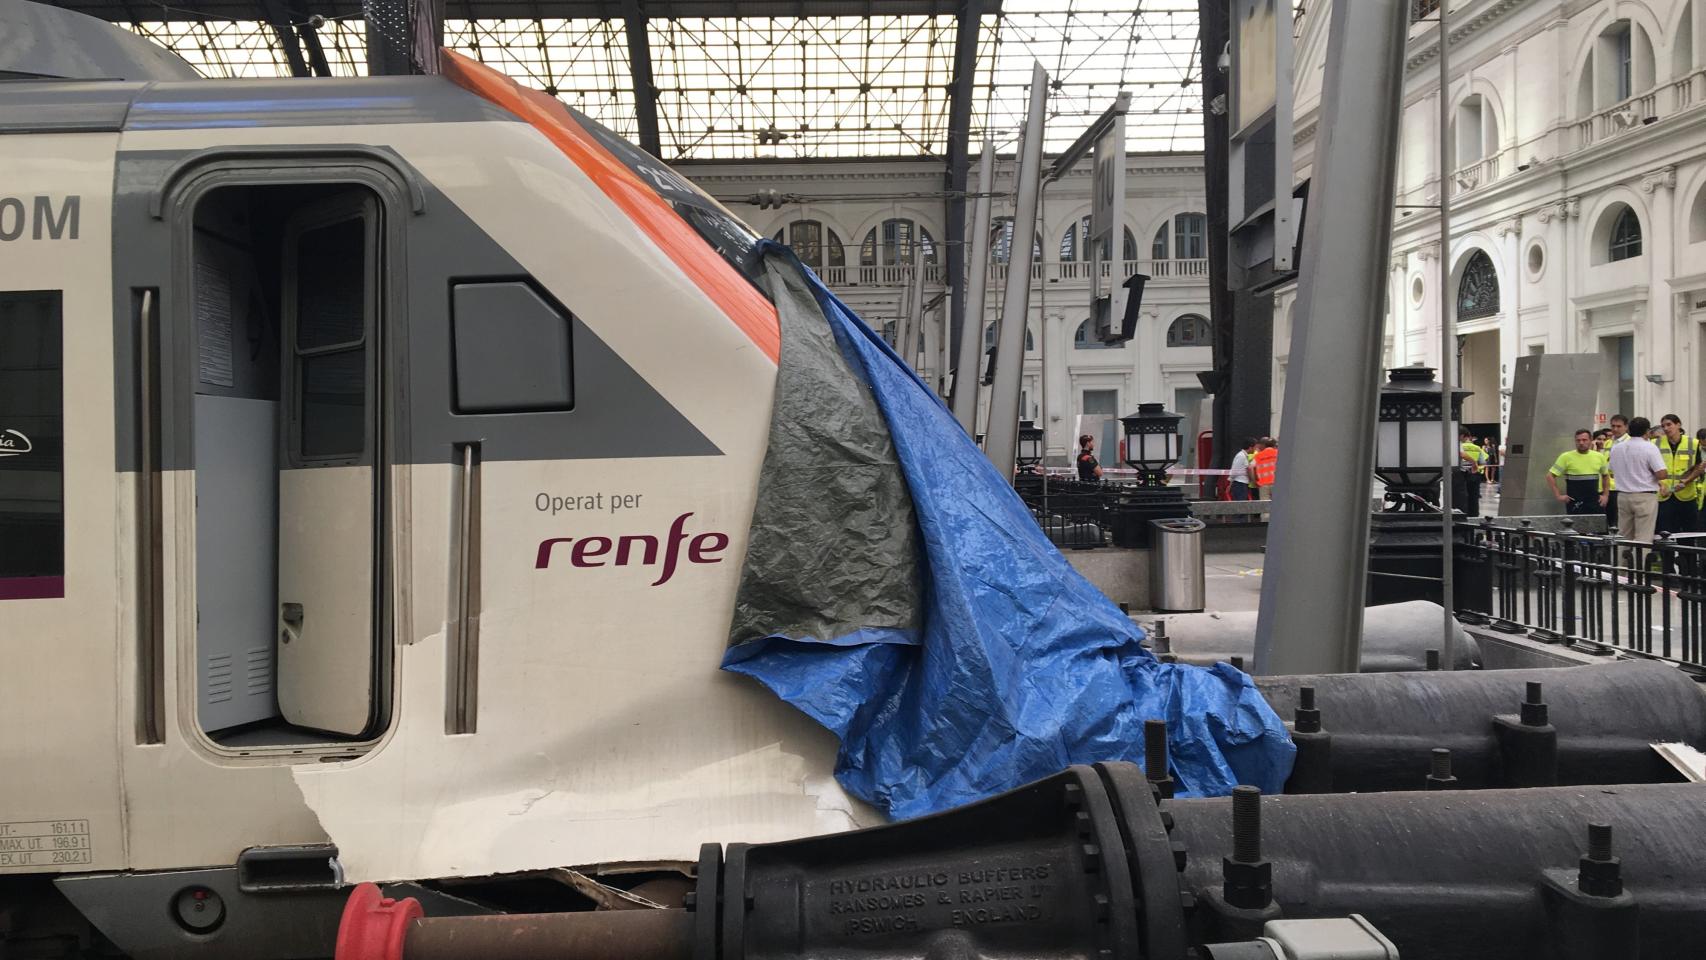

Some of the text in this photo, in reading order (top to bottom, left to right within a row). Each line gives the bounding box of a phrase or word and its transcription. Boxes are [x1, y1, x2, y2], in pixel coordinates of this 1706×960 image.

[535, 492, 643, 516] Operat per
[535, 511, 730, 586] renfe
[52, 836, 79, 848] 196.9
[52, 851, 80, 863] 230.2
[829, 865, 1050, 896] HYDRAULIC BUFFERS
[830, 892, 925, 916] RANSOMES
[937, 890, 952, 905] &
[959, 886, 1024, 904] RAPIER
[844, 904, 1042, 936] IPSWICH ENGLAND
